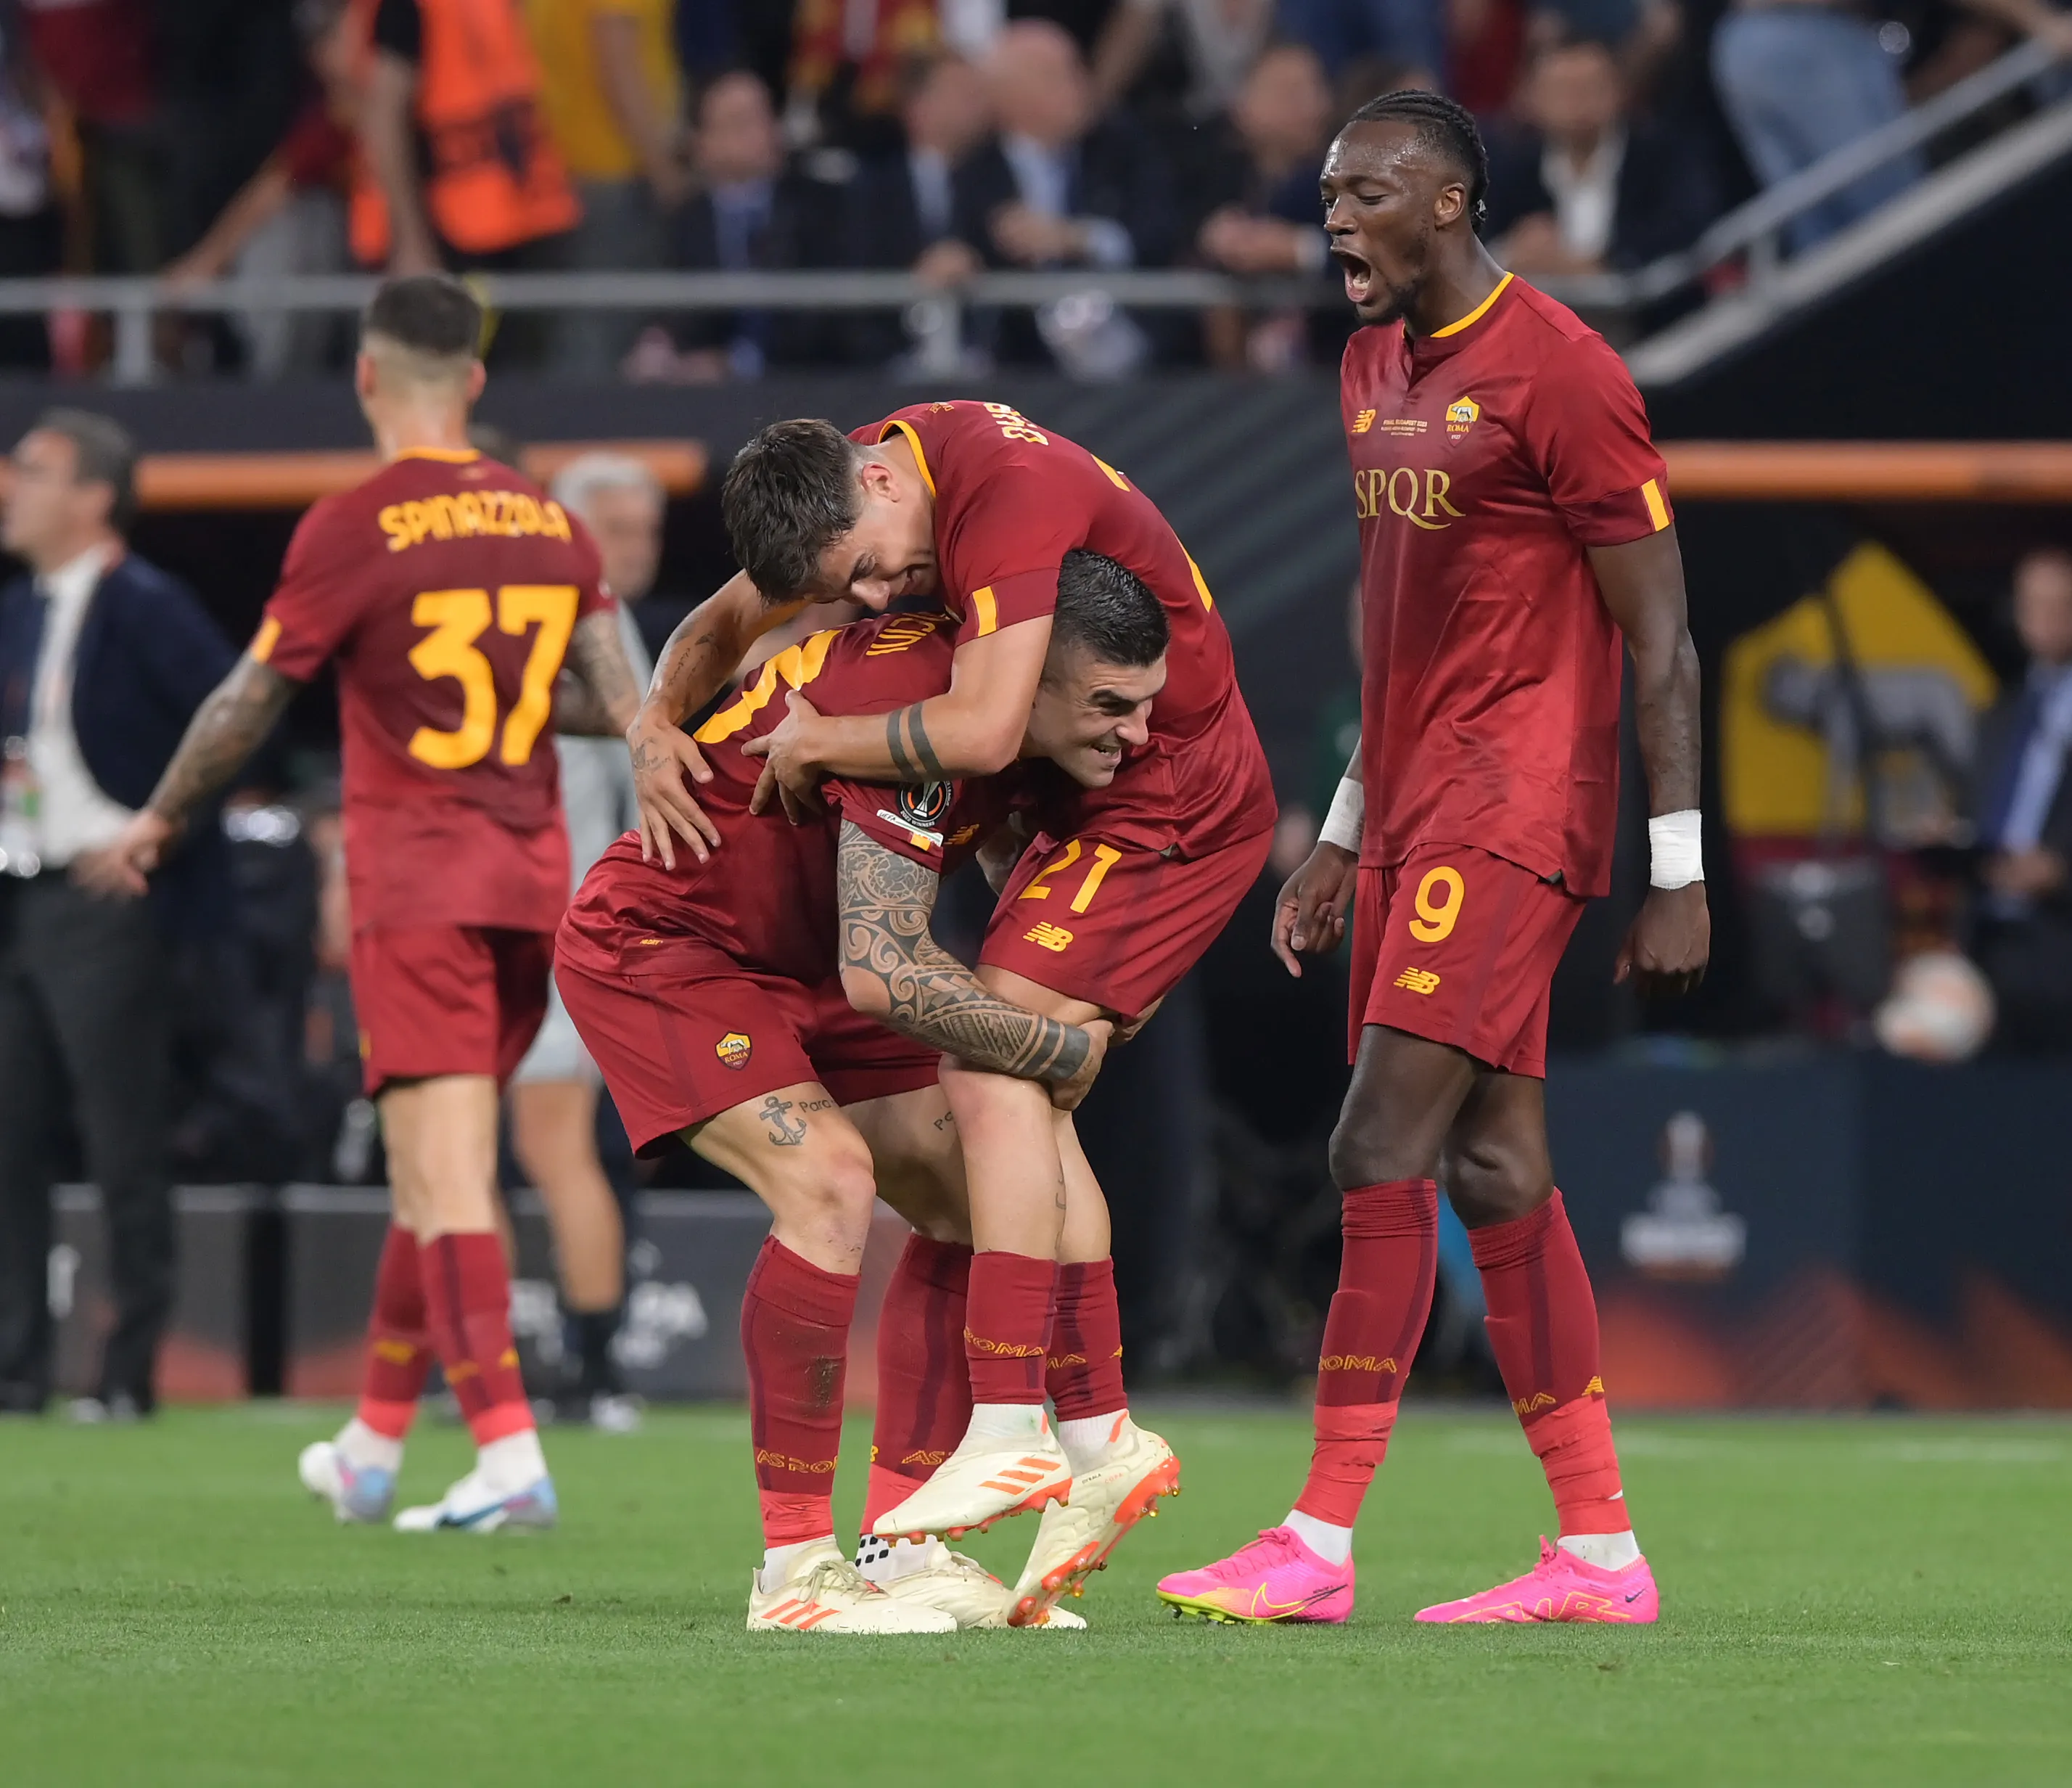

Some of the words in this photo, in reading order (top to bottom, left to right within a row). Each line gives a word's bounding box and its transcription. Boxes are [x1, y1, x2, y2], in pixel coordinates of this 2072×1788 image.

[1446, 425, 1469, 433] ROMA
[378, 490, 572, 553] SPINAZZOLA
[1355, 467, 1466, 530] SPQR
[407, 584, 580, 770] 37
[1017, 838, 1122, 914] 21
[1408, 865, 1465, 943] 9
[724, 1051, 748, 1064] ROMA
[757, 1450, 784, 1467] AS
[789, 1456, 837, 1473] RO
